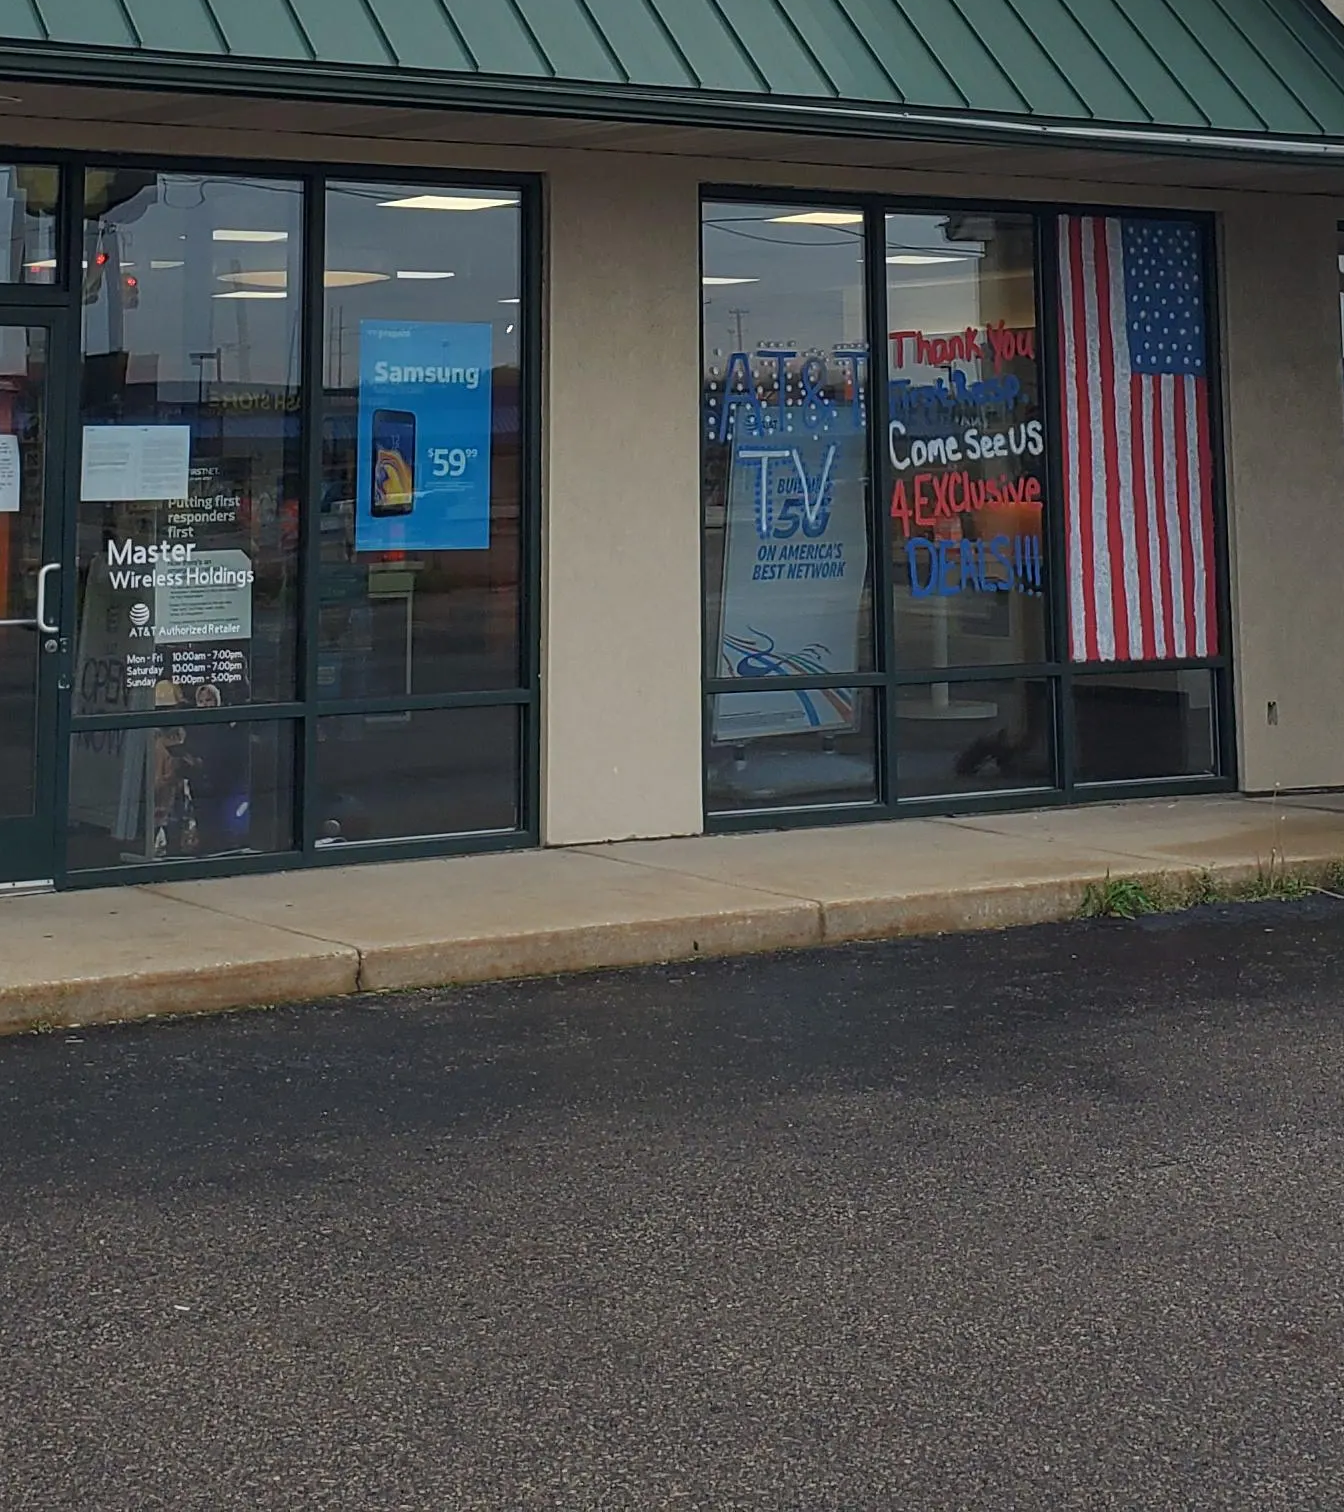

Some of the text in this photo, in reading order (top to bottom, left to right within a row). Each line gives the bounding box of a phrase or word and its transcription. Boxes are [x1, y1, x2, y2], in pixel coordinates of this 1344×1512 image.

[889, 320, 1035, 375] Thank You
[374, 361, 479, 389] Samsung
[720, 349, 869, 444] AT&T
[889, 420, 962, 470] Come
[964, 428, 1007, 460] See
[737, 443, 838, 536] TV
[167, 495, 240, 509] Putting first
[890, 478, 913, 537] 4
[167, 510, 236, 524] responders
[167, 526, 194, 538] first
[108, 539, 196, 566] Master
[758, 543, 843, 561] ON AMERICA'S
[109, 566, 254, 590] Wireless Holdings
[752, 561, 846, 580] BEST NETWORK
[129, 623, 240, 638] AT&T Authorized Retailer
[126, 654, 145, 664] Mon
[152, 653, 163, 663] Fri
[126, 665, 164, 676] Saturday
[126, 677, 156, 688] Sunday
